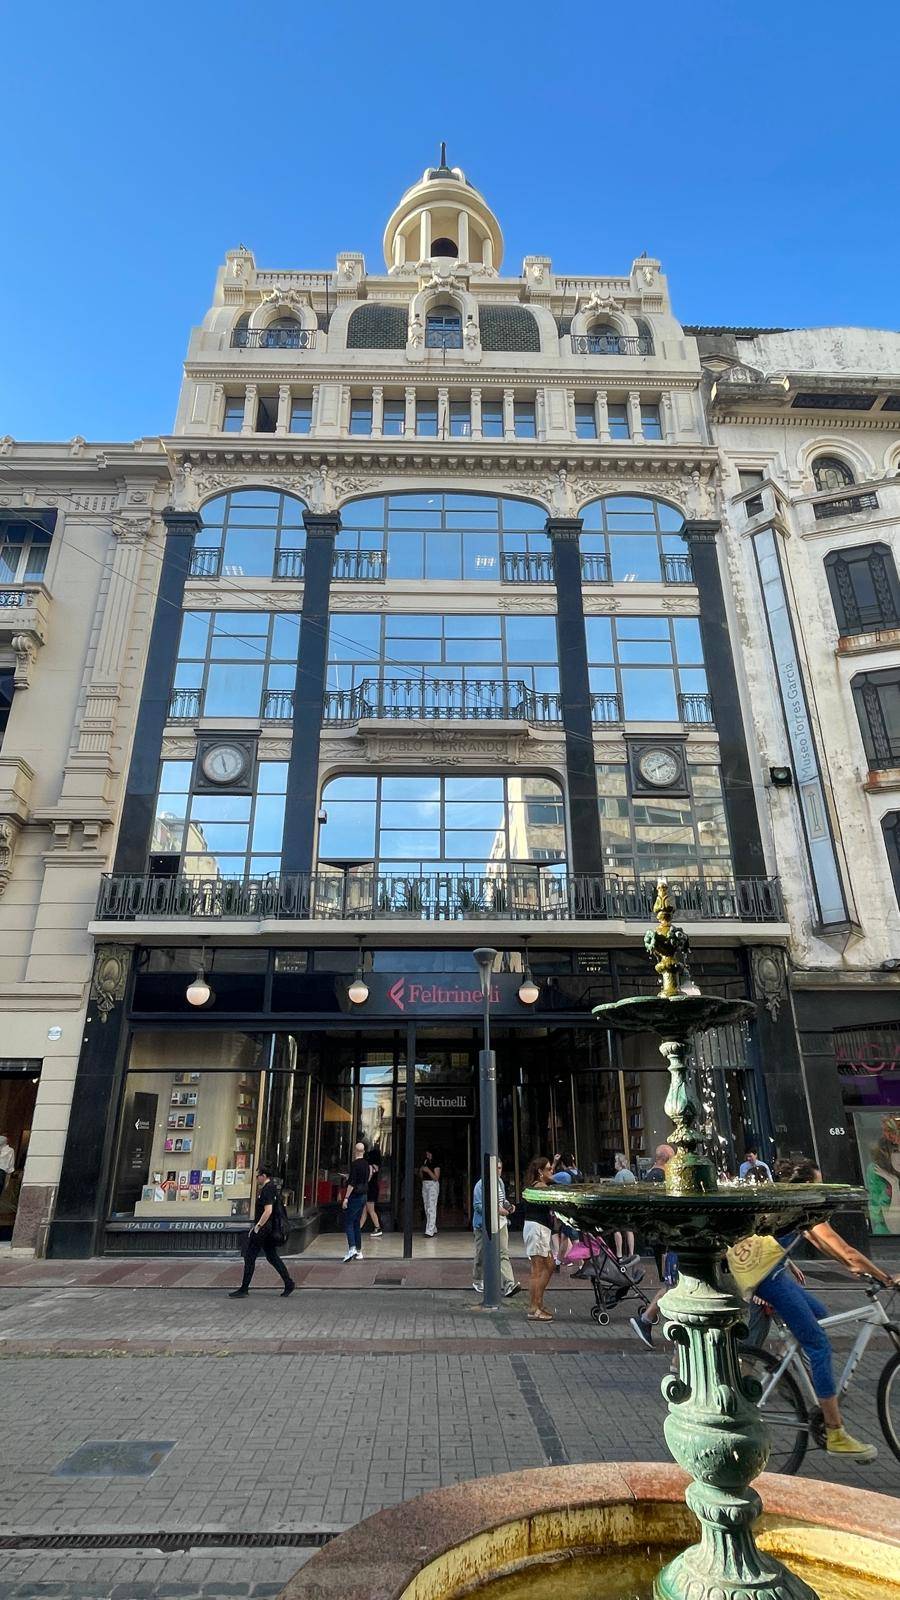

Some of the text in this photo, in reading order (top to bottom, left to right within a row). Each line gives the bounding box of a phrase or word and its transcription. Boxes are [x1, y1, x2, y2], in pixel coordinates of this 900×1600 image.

[794, 700, 806, 740] Torres
[382, 741, 505, 752] PABLO FERRANDO
[800, 738, 812, 778] Museo
[408, 984, 500, 1003] Feltrineli
[416, 1095, 467, 1107] Feltrinelli
[128, 1222, 225, 1230] PABLO FERRANDO
